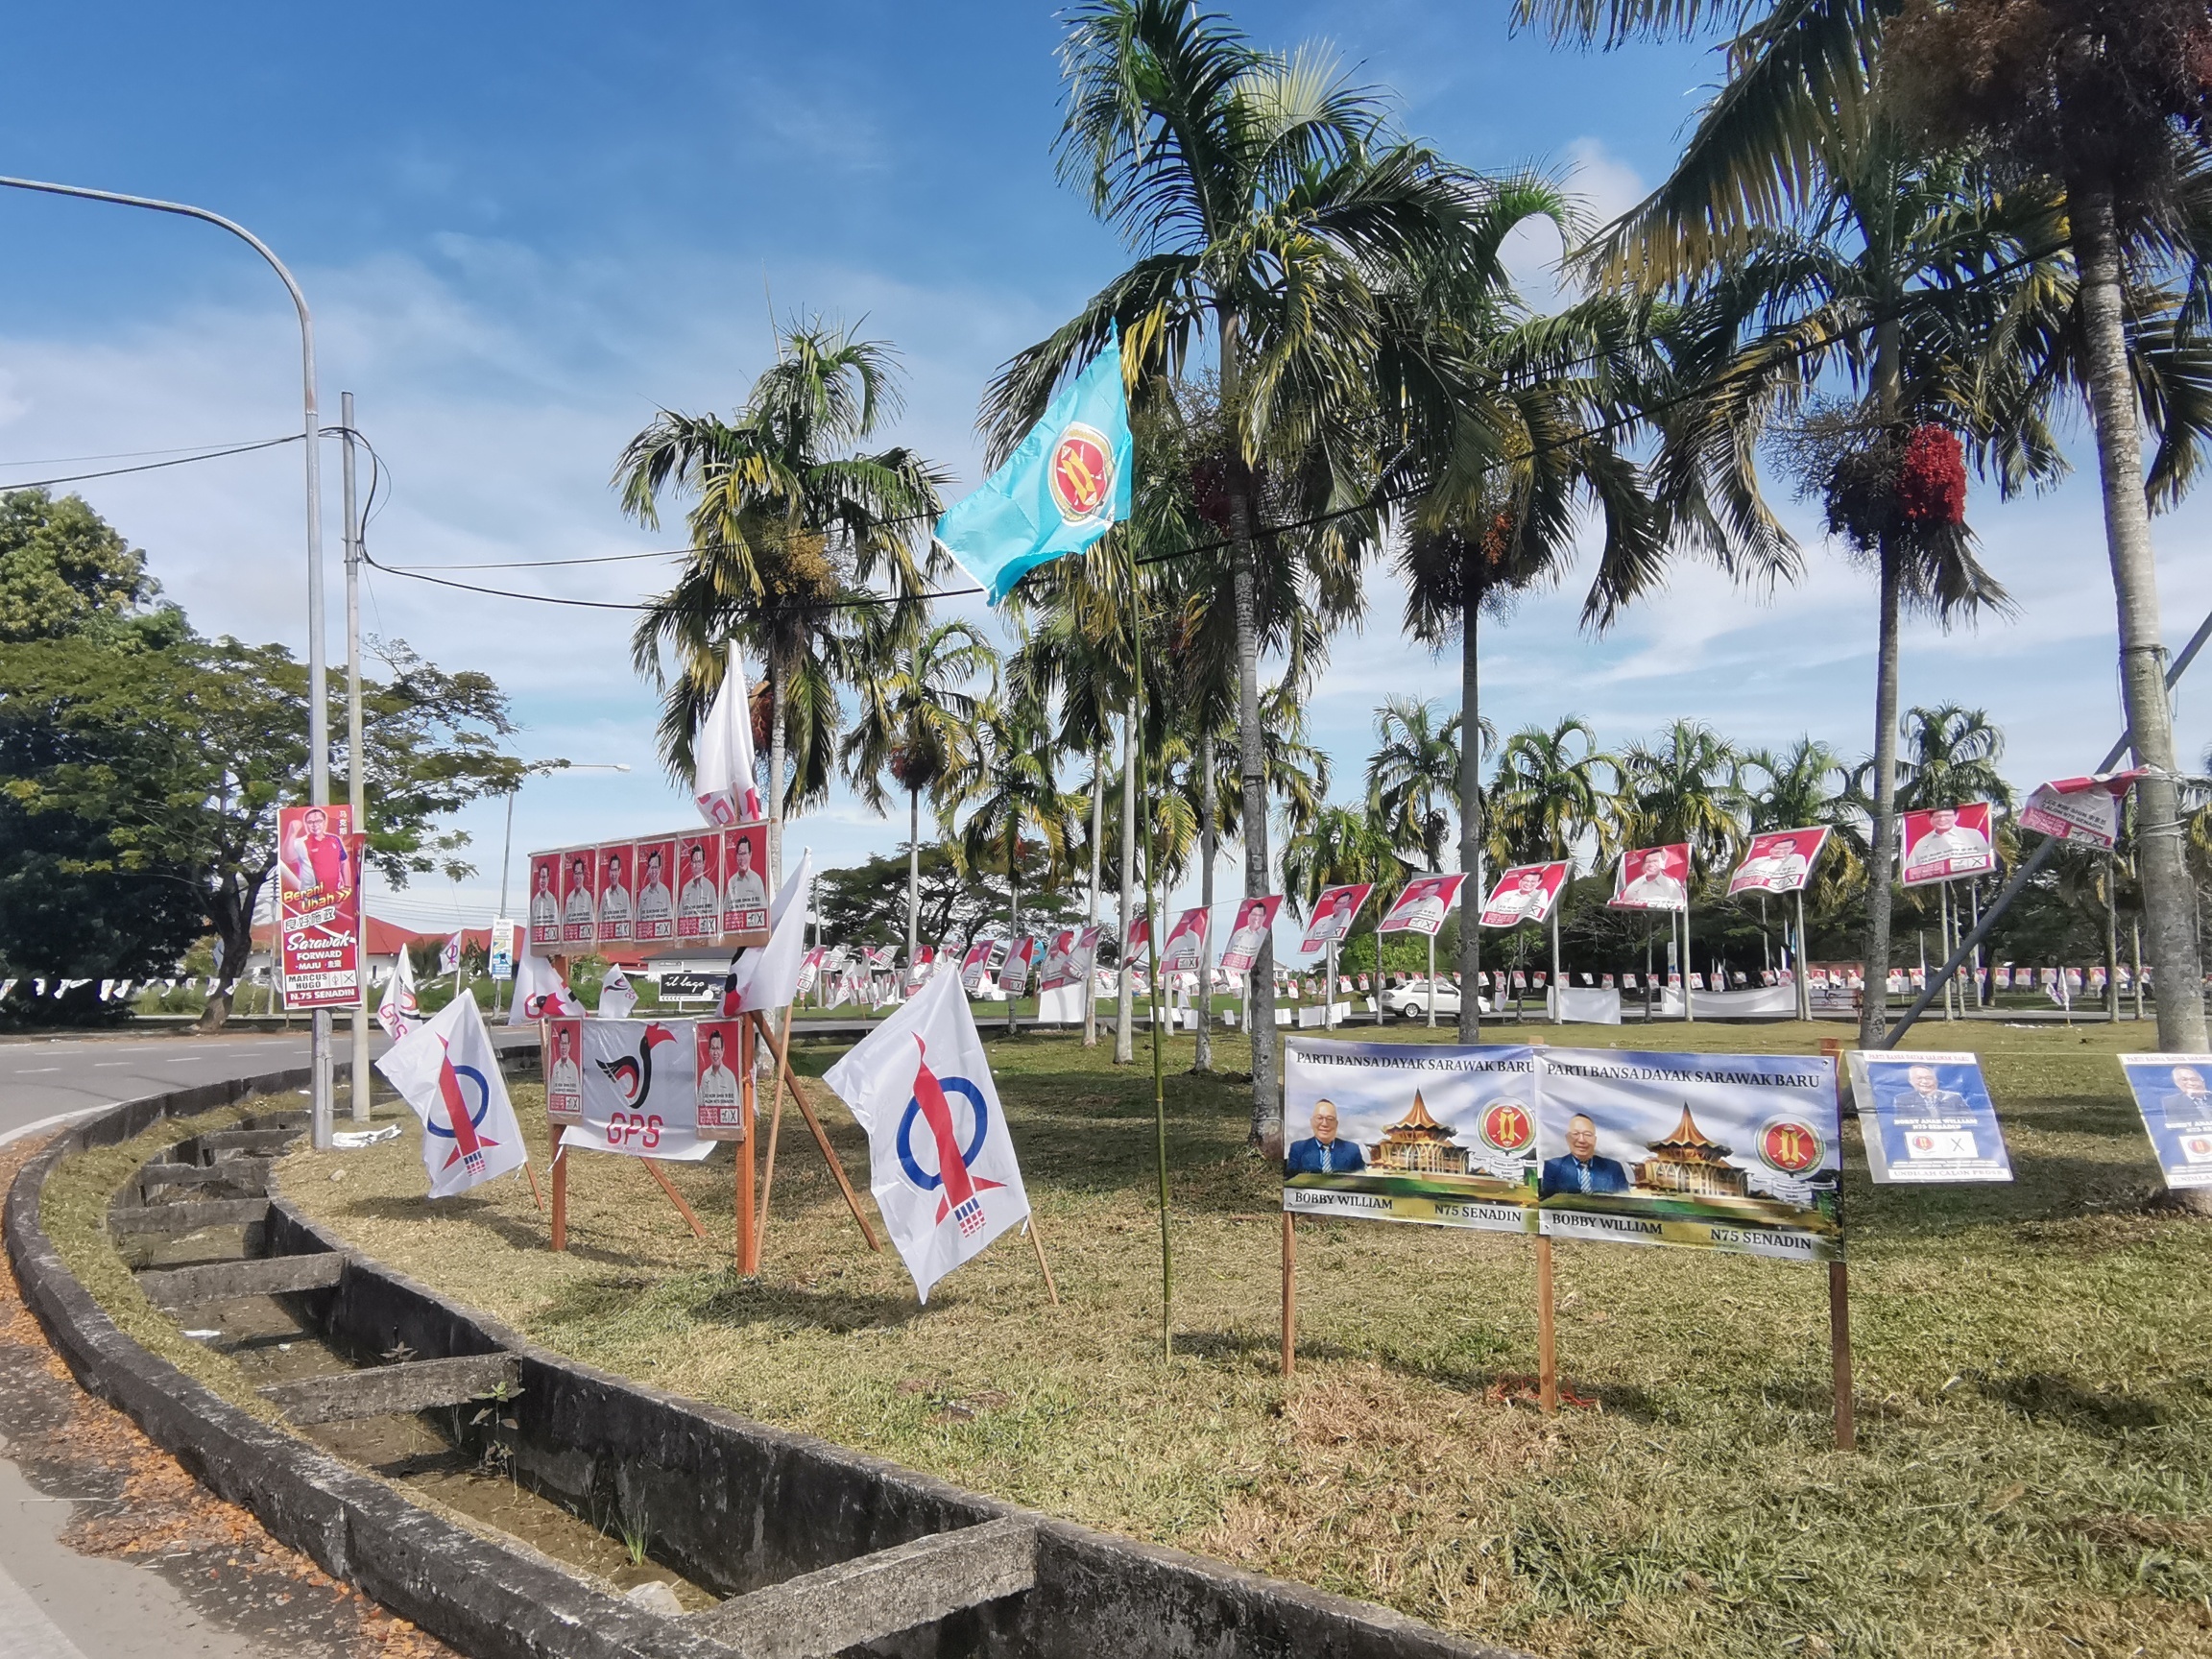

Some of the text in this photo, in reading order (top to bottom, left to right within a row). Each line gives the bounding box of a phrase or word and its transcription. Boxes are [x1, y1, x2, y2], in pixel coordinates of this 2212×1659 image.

[283, 880, 325, 903] Berani
[301, 893, 335, 912] Ubah
[288, 929, 351, 951] Sarawak
[296, 950, 343, 961] FORWARD
[288, 973, 328, 983] MARCUS
[296, 981, 322, 990] HUGO
[680, 975, 705, 993] lago
[290, 988, 355, 1000] N.75 SENADIN
[1296, 1051, 1334, 1065] PARTI
[1335, 1054, 1380, 1068] BANSA
[1382, 1056, 1427, 1070] DAYAK
[1428, 1058, 1496, 1072] SARAWAK
[1547, 1063, 1819, 1088] PARTI BANSA DAYAK SARAWAK BARU
[606, 1112, 663, 1148] GPS
[1295, 1191, 1393, 1210] BOBBY WILLIAM
[1434, 1203, 1522, 1222] N75 SENADIN
[1551, 1213, 1663, 1235] BOBBY WILLIAM
[1711, 1228, 1812, 1250] N75 SENADIN
